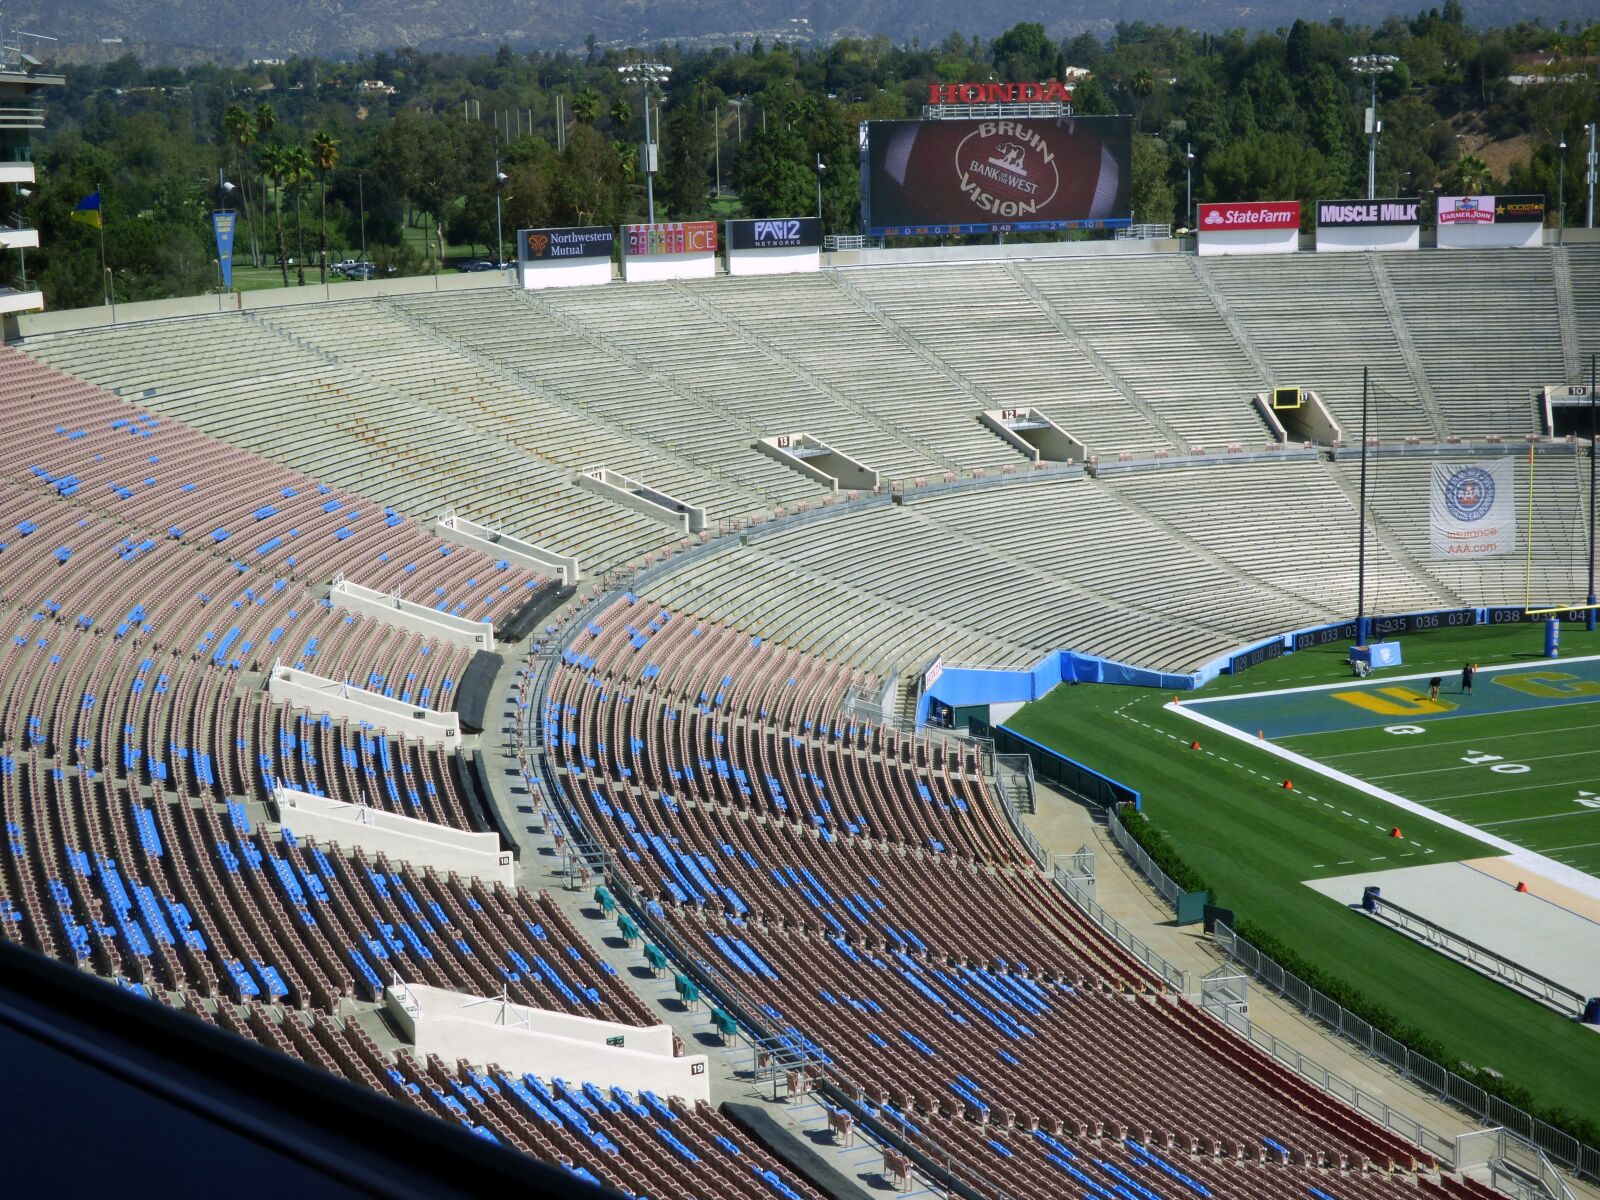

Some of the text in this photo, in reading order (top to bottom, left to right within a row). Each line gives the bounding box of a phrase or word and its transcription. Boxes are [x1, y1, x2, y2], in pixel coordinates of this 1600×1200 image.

[927, 82, 1072, 104] HONDA
[979, 121, 1055, 164] BRUIN
[970, 160, 1000, 181] BANK
[1008, 174, 1039, 195] WEST
[960, 172, 1037, 217] VISION
[1321, 203, 1418, 223] MUSCLE MILK
[1441, 210, 1492, 221] FARMER JOHN
[550, 232, 612, 244] Northwestern
[688, 230, 715, 249] ICE
[755, 239, 801, 247] NETWORKS
[551, 244, 583, 256] Mutual
[1571, 387, 1584, 395] 10
[1004, 410, 1014, 419] 12
[1448, 543, 1497, 554] AAA.com
[1416, 615, 1439, 629] 036
[1448, 612, 1471, 625] 037
[1494, 610, 1520, 622] 038
[1569, 610, 1586, 621] 04
[1298, 625, 1358, 648] 032 033 03
[1383, 724, 1427, 735] G
[500, 857, 509, 865] 18
[692, 1064, 704, 1074] 19
